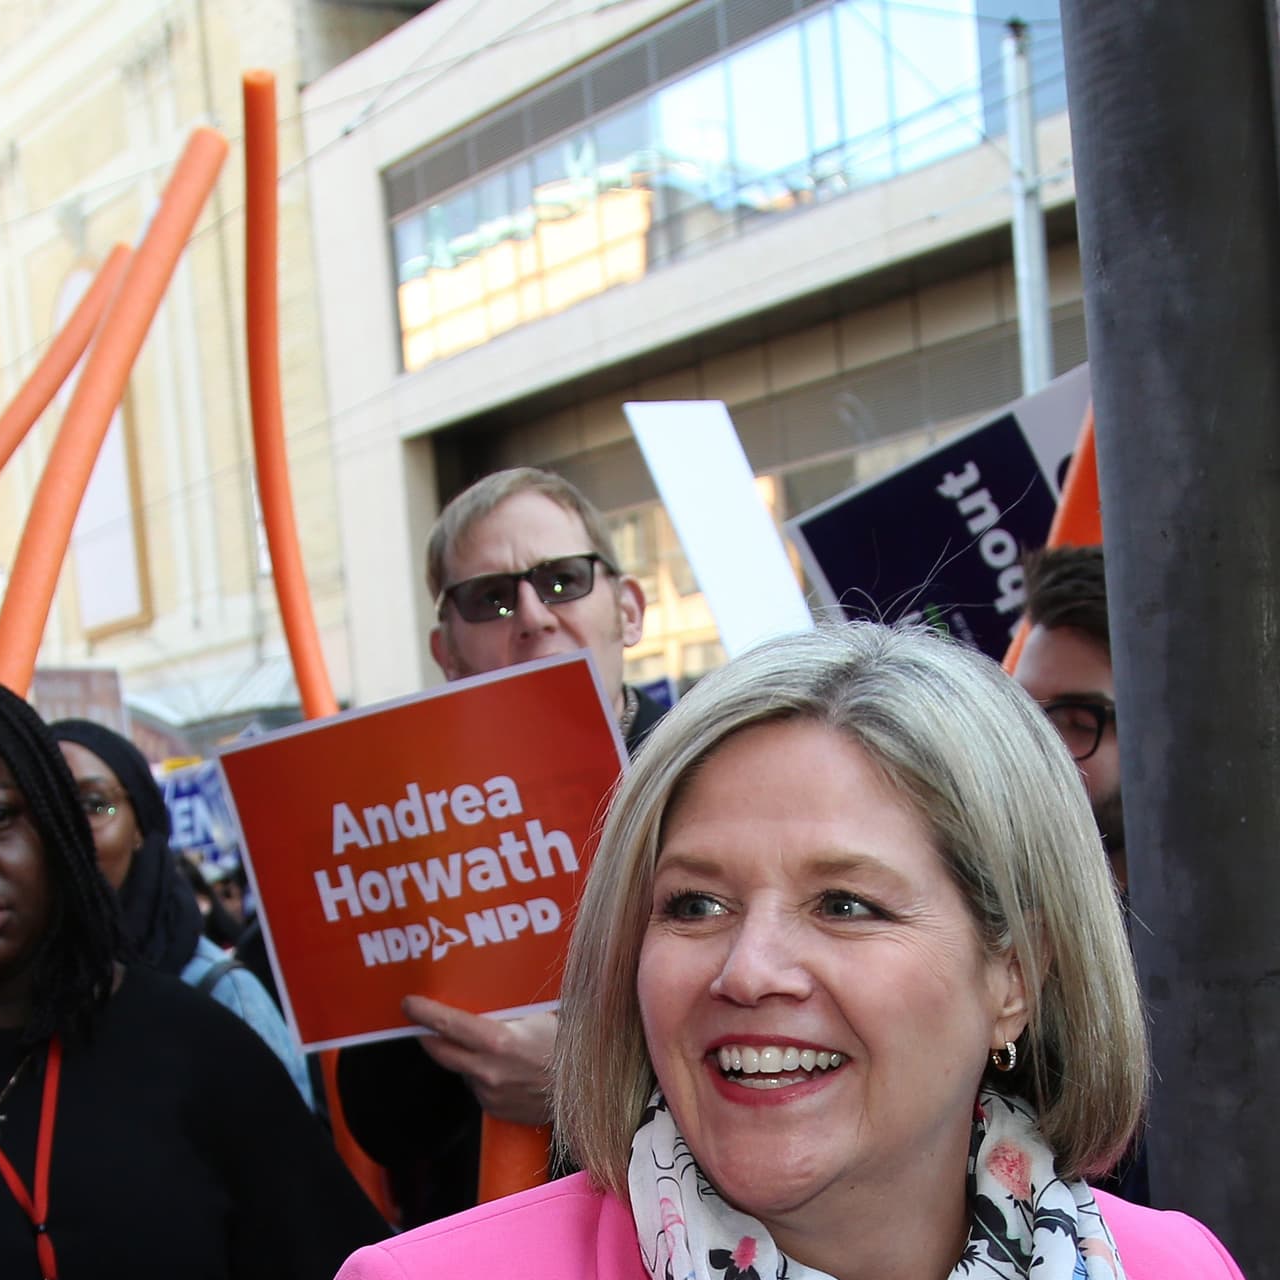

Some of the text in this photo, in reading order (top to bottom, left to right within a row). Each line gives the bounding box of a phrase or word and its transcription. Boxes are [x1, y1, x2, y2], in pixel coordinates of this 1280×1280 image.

[935, 460, 1029, 638] bout
[332, 775, 523, 856] Andrea
[313, 819, 580, 923] Horwath
[357, 897, 562, 968] NDP NPD
